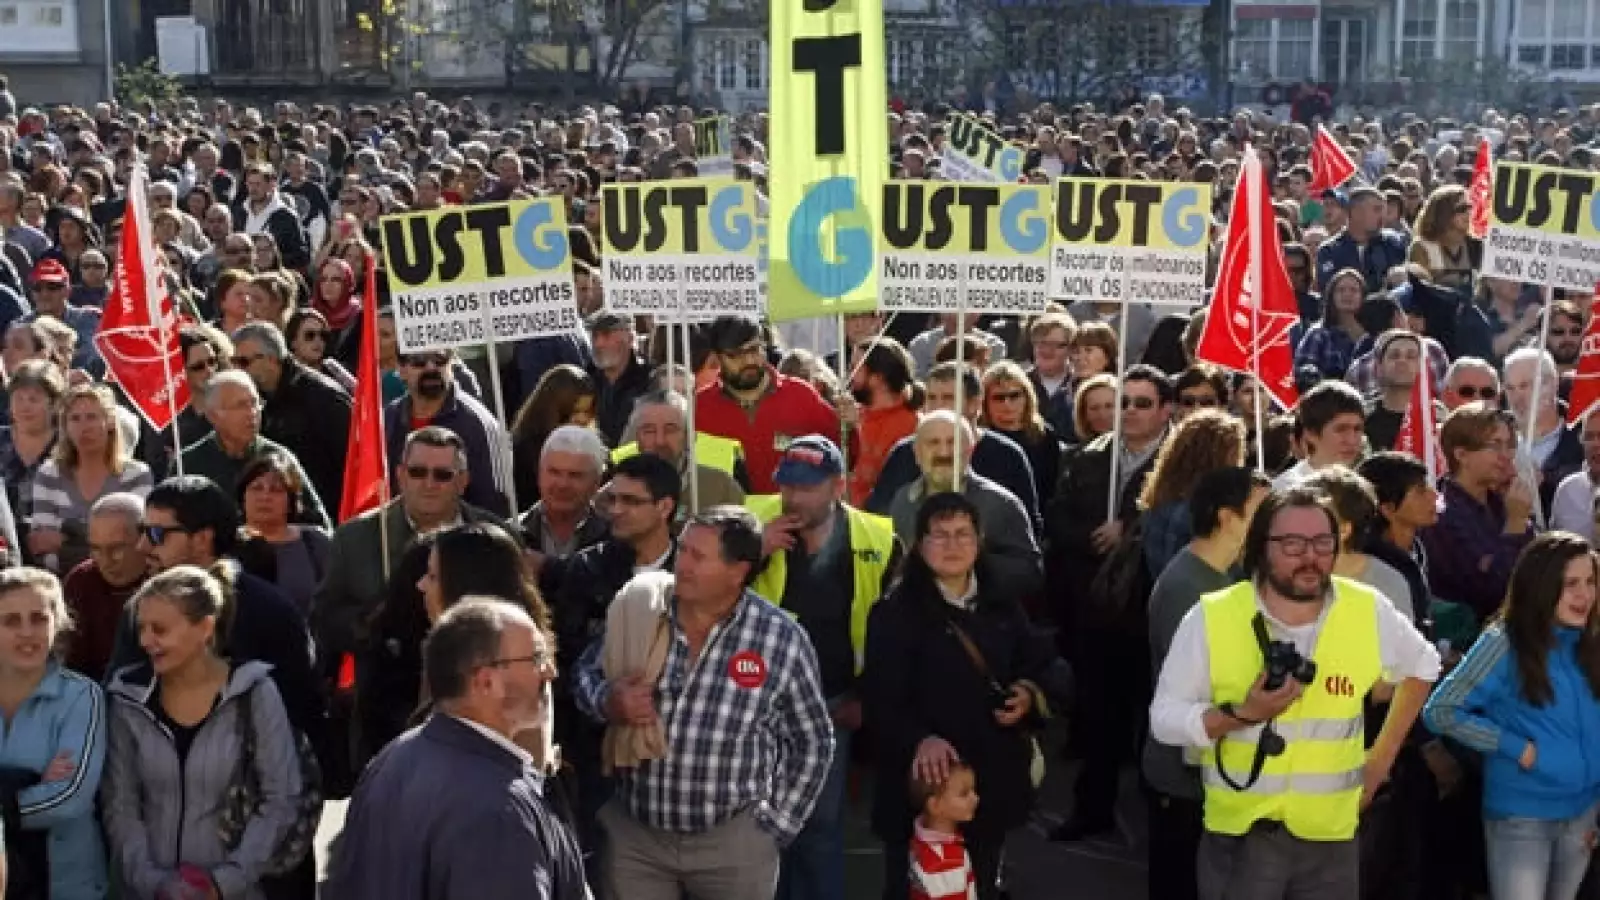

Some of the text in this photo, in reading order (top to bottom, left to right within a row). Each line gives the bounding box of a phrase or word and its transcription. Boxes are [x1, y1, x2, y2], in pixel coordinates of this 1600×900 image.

[787, 0, 873, 298] TG
[950, 114, 1020, 181] USTG
[384, 201, 568, 285] USTG
[605, 186, 753, 252] USTG
[882, 184, 1047, 254] USTG
[1056, 183, 1205, 248] USTG
[399, 281, 573, 318] Non aos recortes
[609, 261, 756, 282] Non aos recortes
[883, 256, 1046, 283] Non aos recortes
[1062, 276, 1093, 296] NON
